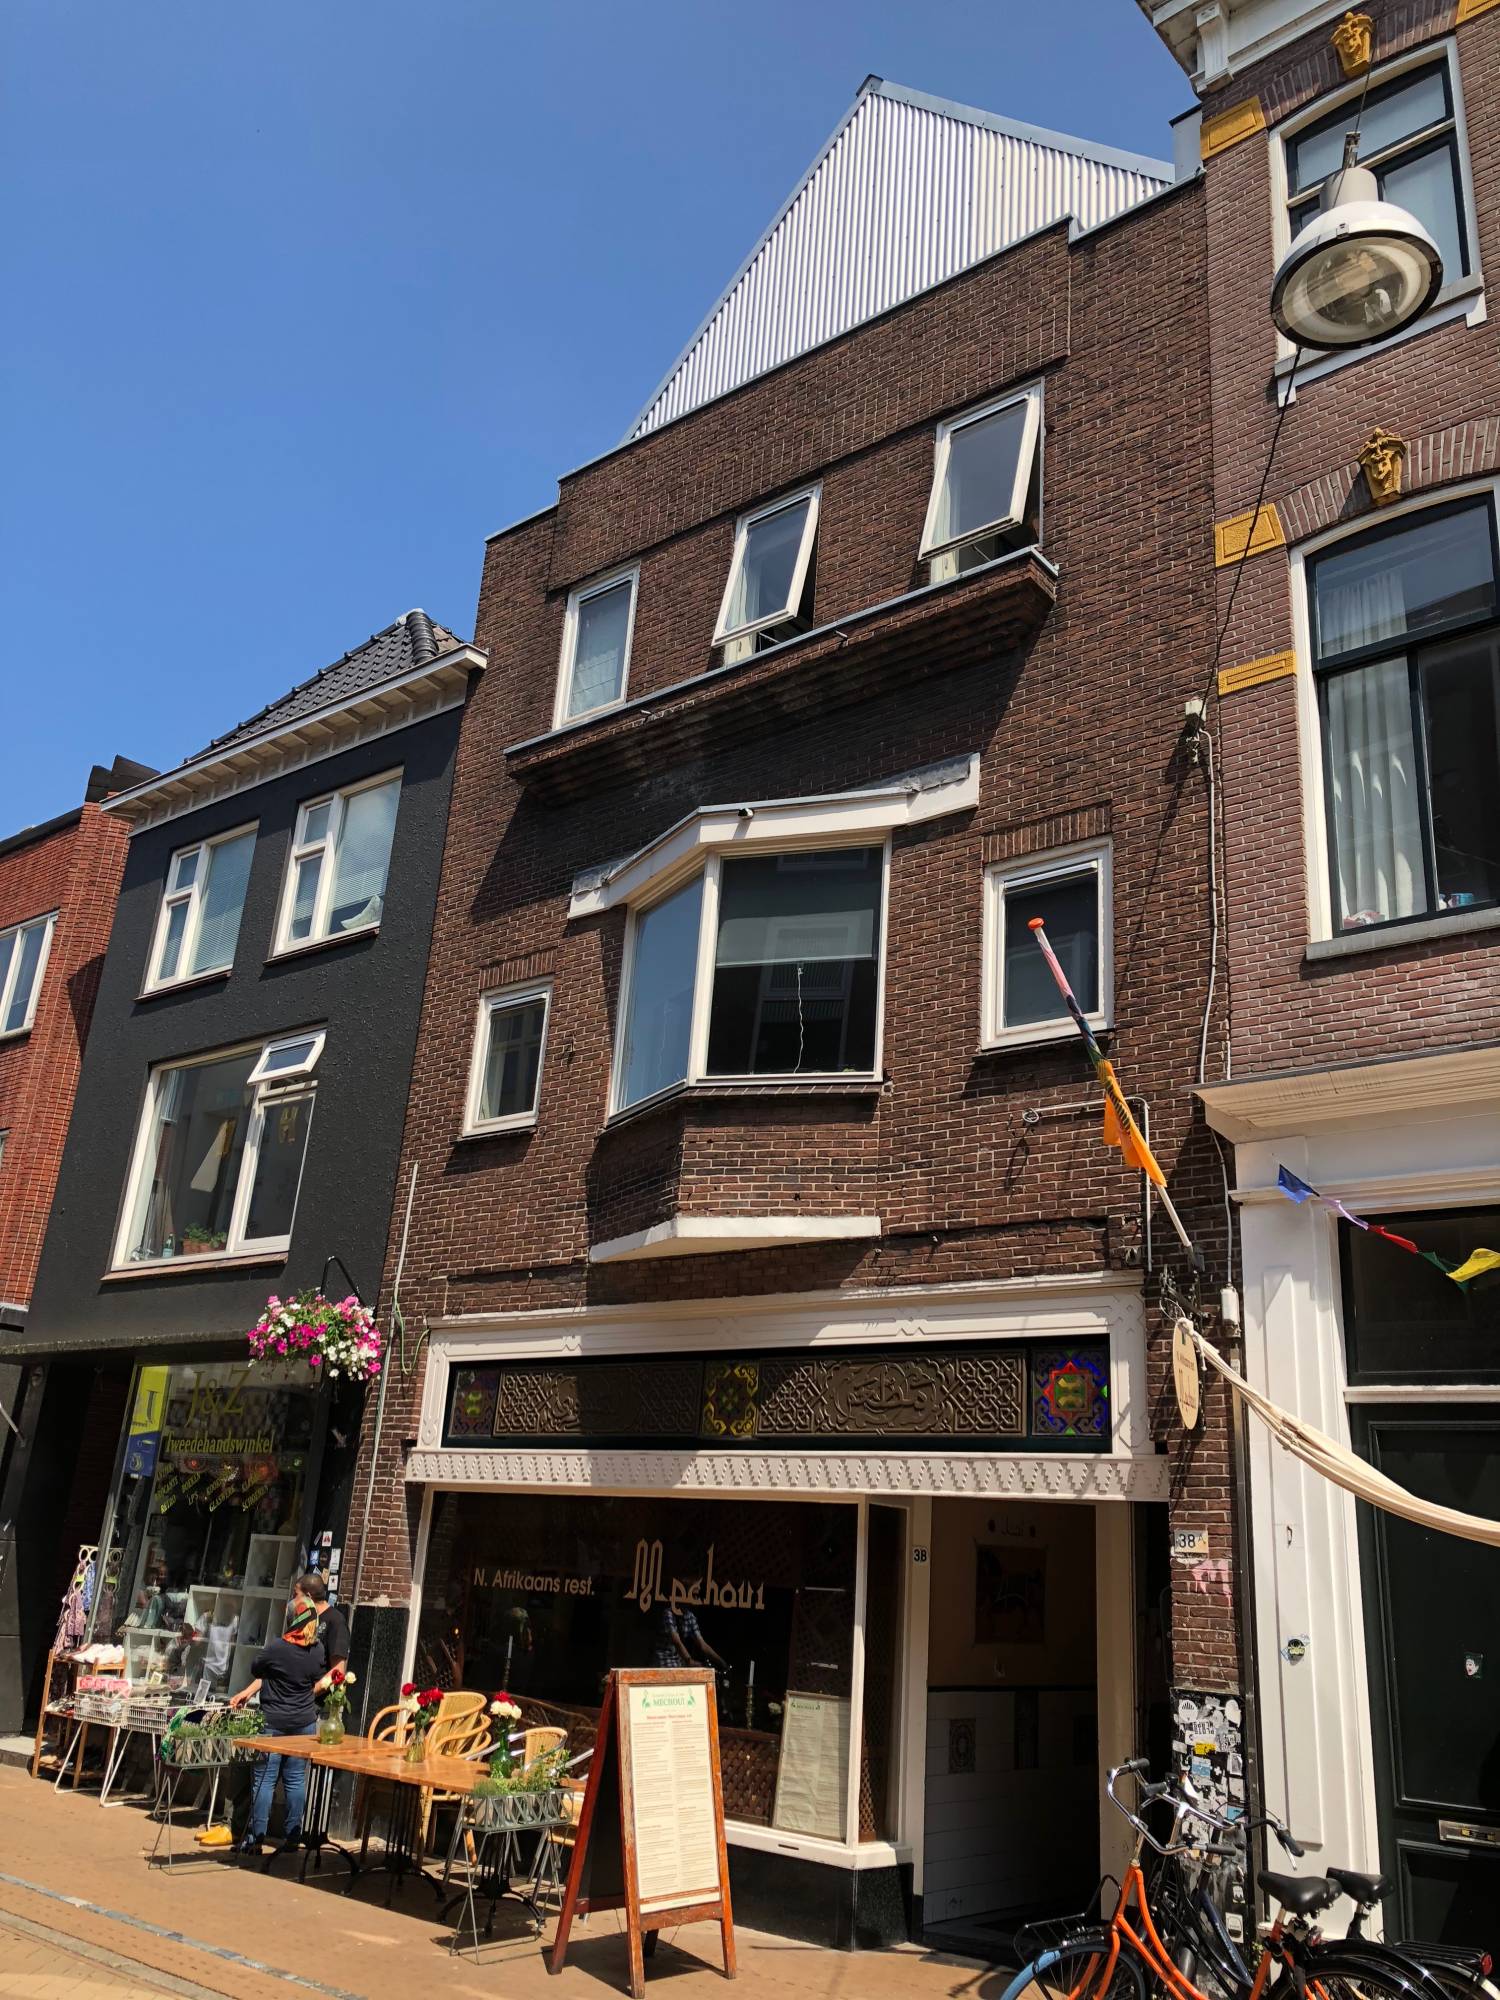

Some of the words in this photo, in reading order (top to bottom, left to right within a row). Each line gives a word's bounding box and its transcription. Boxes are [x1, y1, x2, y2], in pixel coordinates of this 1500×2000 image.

[184, 1368, 251, 1429] J&Z
[166, 1430, 273, 1453] Tweedehandswinkel
[1179, 1534, 1195, 1548] 38
[913, 1548, 927, 1562] 38
[474, 1568, 488, 1587] N.
[492, 1569, 561, 1593] Afrikaans
[564, 1576, 595, 1596] rest.
